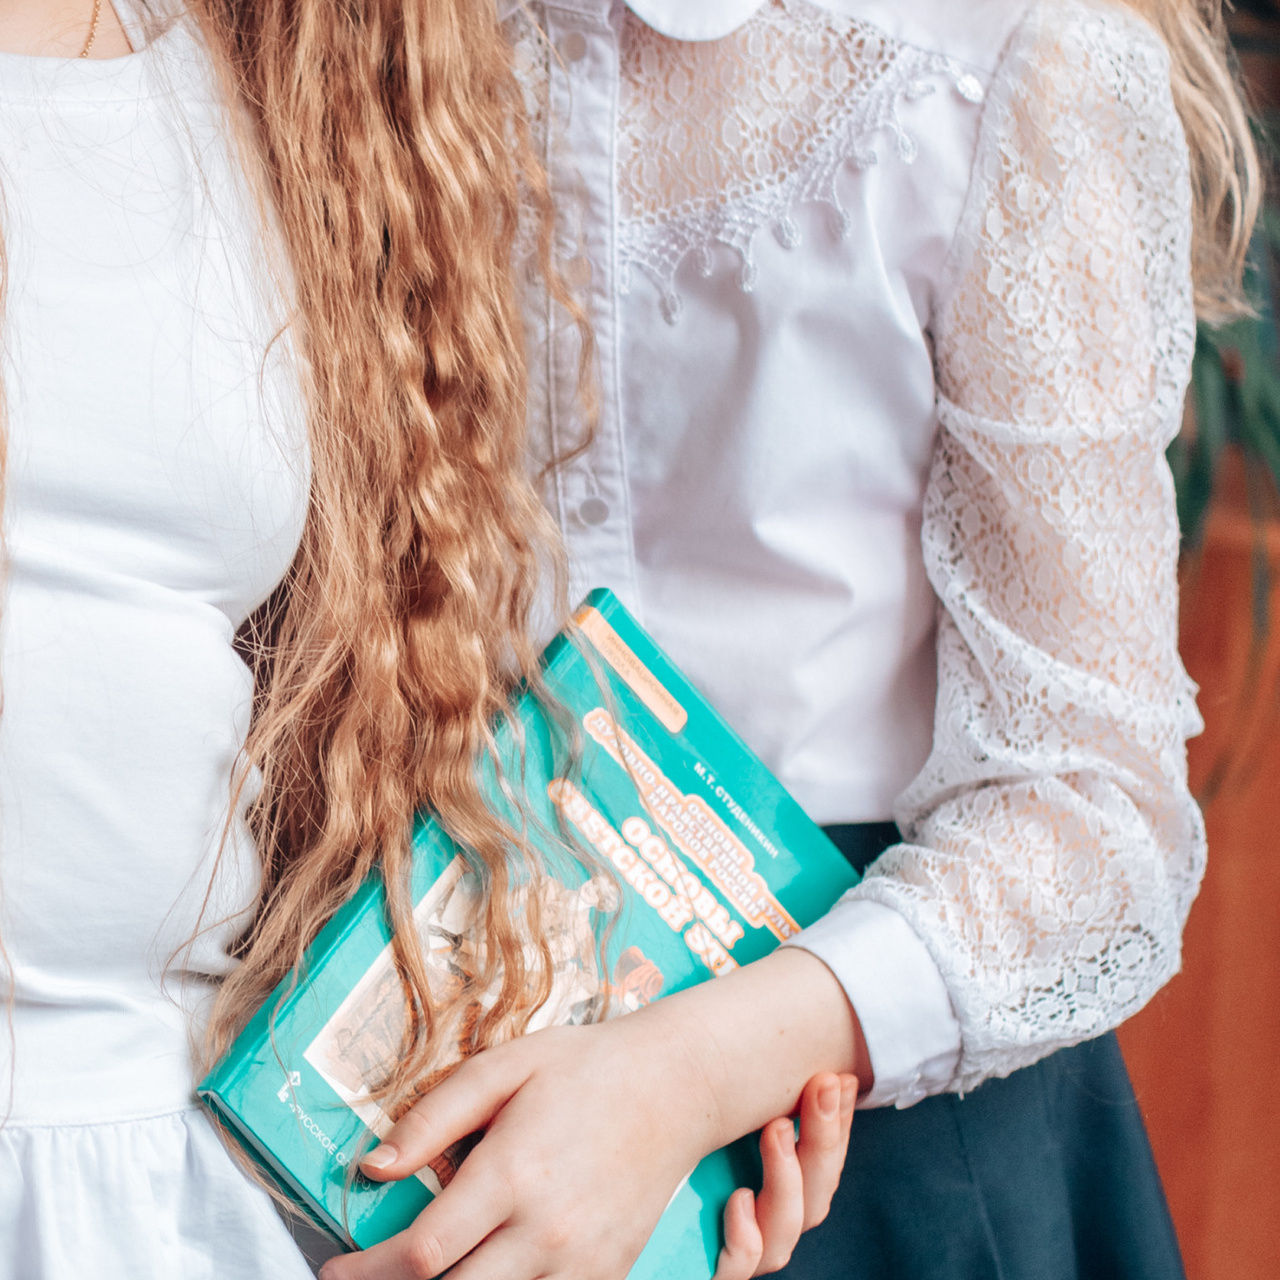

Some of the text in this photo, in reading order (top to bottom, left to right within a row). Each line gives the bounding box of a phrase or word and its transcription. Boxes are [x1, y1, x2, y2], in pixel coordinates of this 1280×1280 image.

[647, 791, 761, 917] НАРОДОВ РОССИИ
[687, 802, 745, 866] ОСНОВЫ
[715, 785, 778, 858] СТУДЕНИКИН
[622, 817, 744, 949] ОСНОВЫ
[756, 896, 795, 938] КУЛЬ
